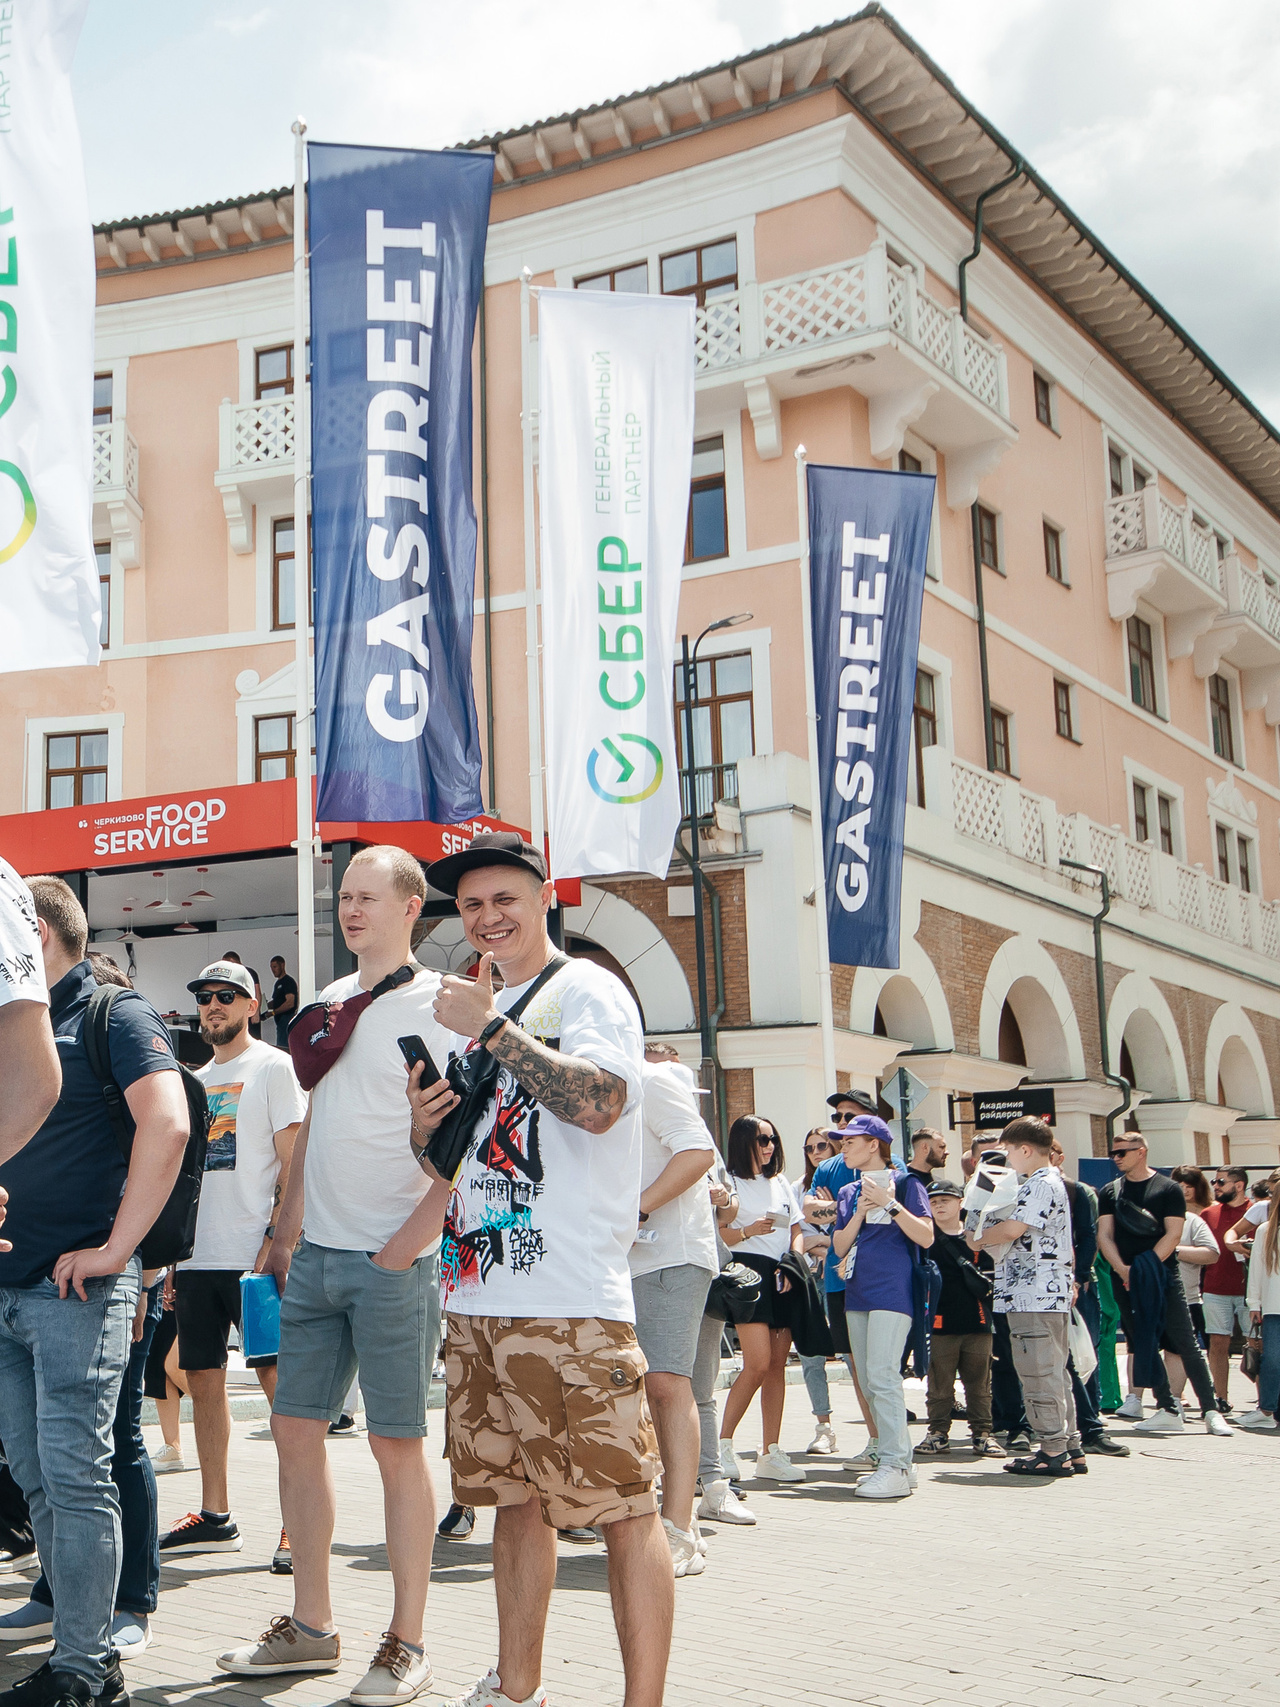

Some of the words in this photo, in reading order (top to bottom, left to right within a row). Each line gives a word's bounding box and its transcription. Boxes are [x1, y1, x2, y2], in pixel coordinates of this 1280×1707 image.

[593, 350, 612, 515] ГЕНЕРАЛЬНЫЙ
[365, 209, 437, 743] GASTREET
[622, 411, 643, 515] ПАРТНЁР
[598, 535, 645, 711] СБЕР
[836, 520, 890, 914] GASTREET
[94, 813, 145, 826] ЧЕРКИЗОВО
[146, 798, 226, 828] FOOD
[94, 820, 208, 856] SERVICE
[979, 1101, 1024, 1110] Академия
[980, 1110, 1023, 1120] райдеров
[510, 1249, 548, 1261] JUST
[510, 1260, 535, 1276] ART
